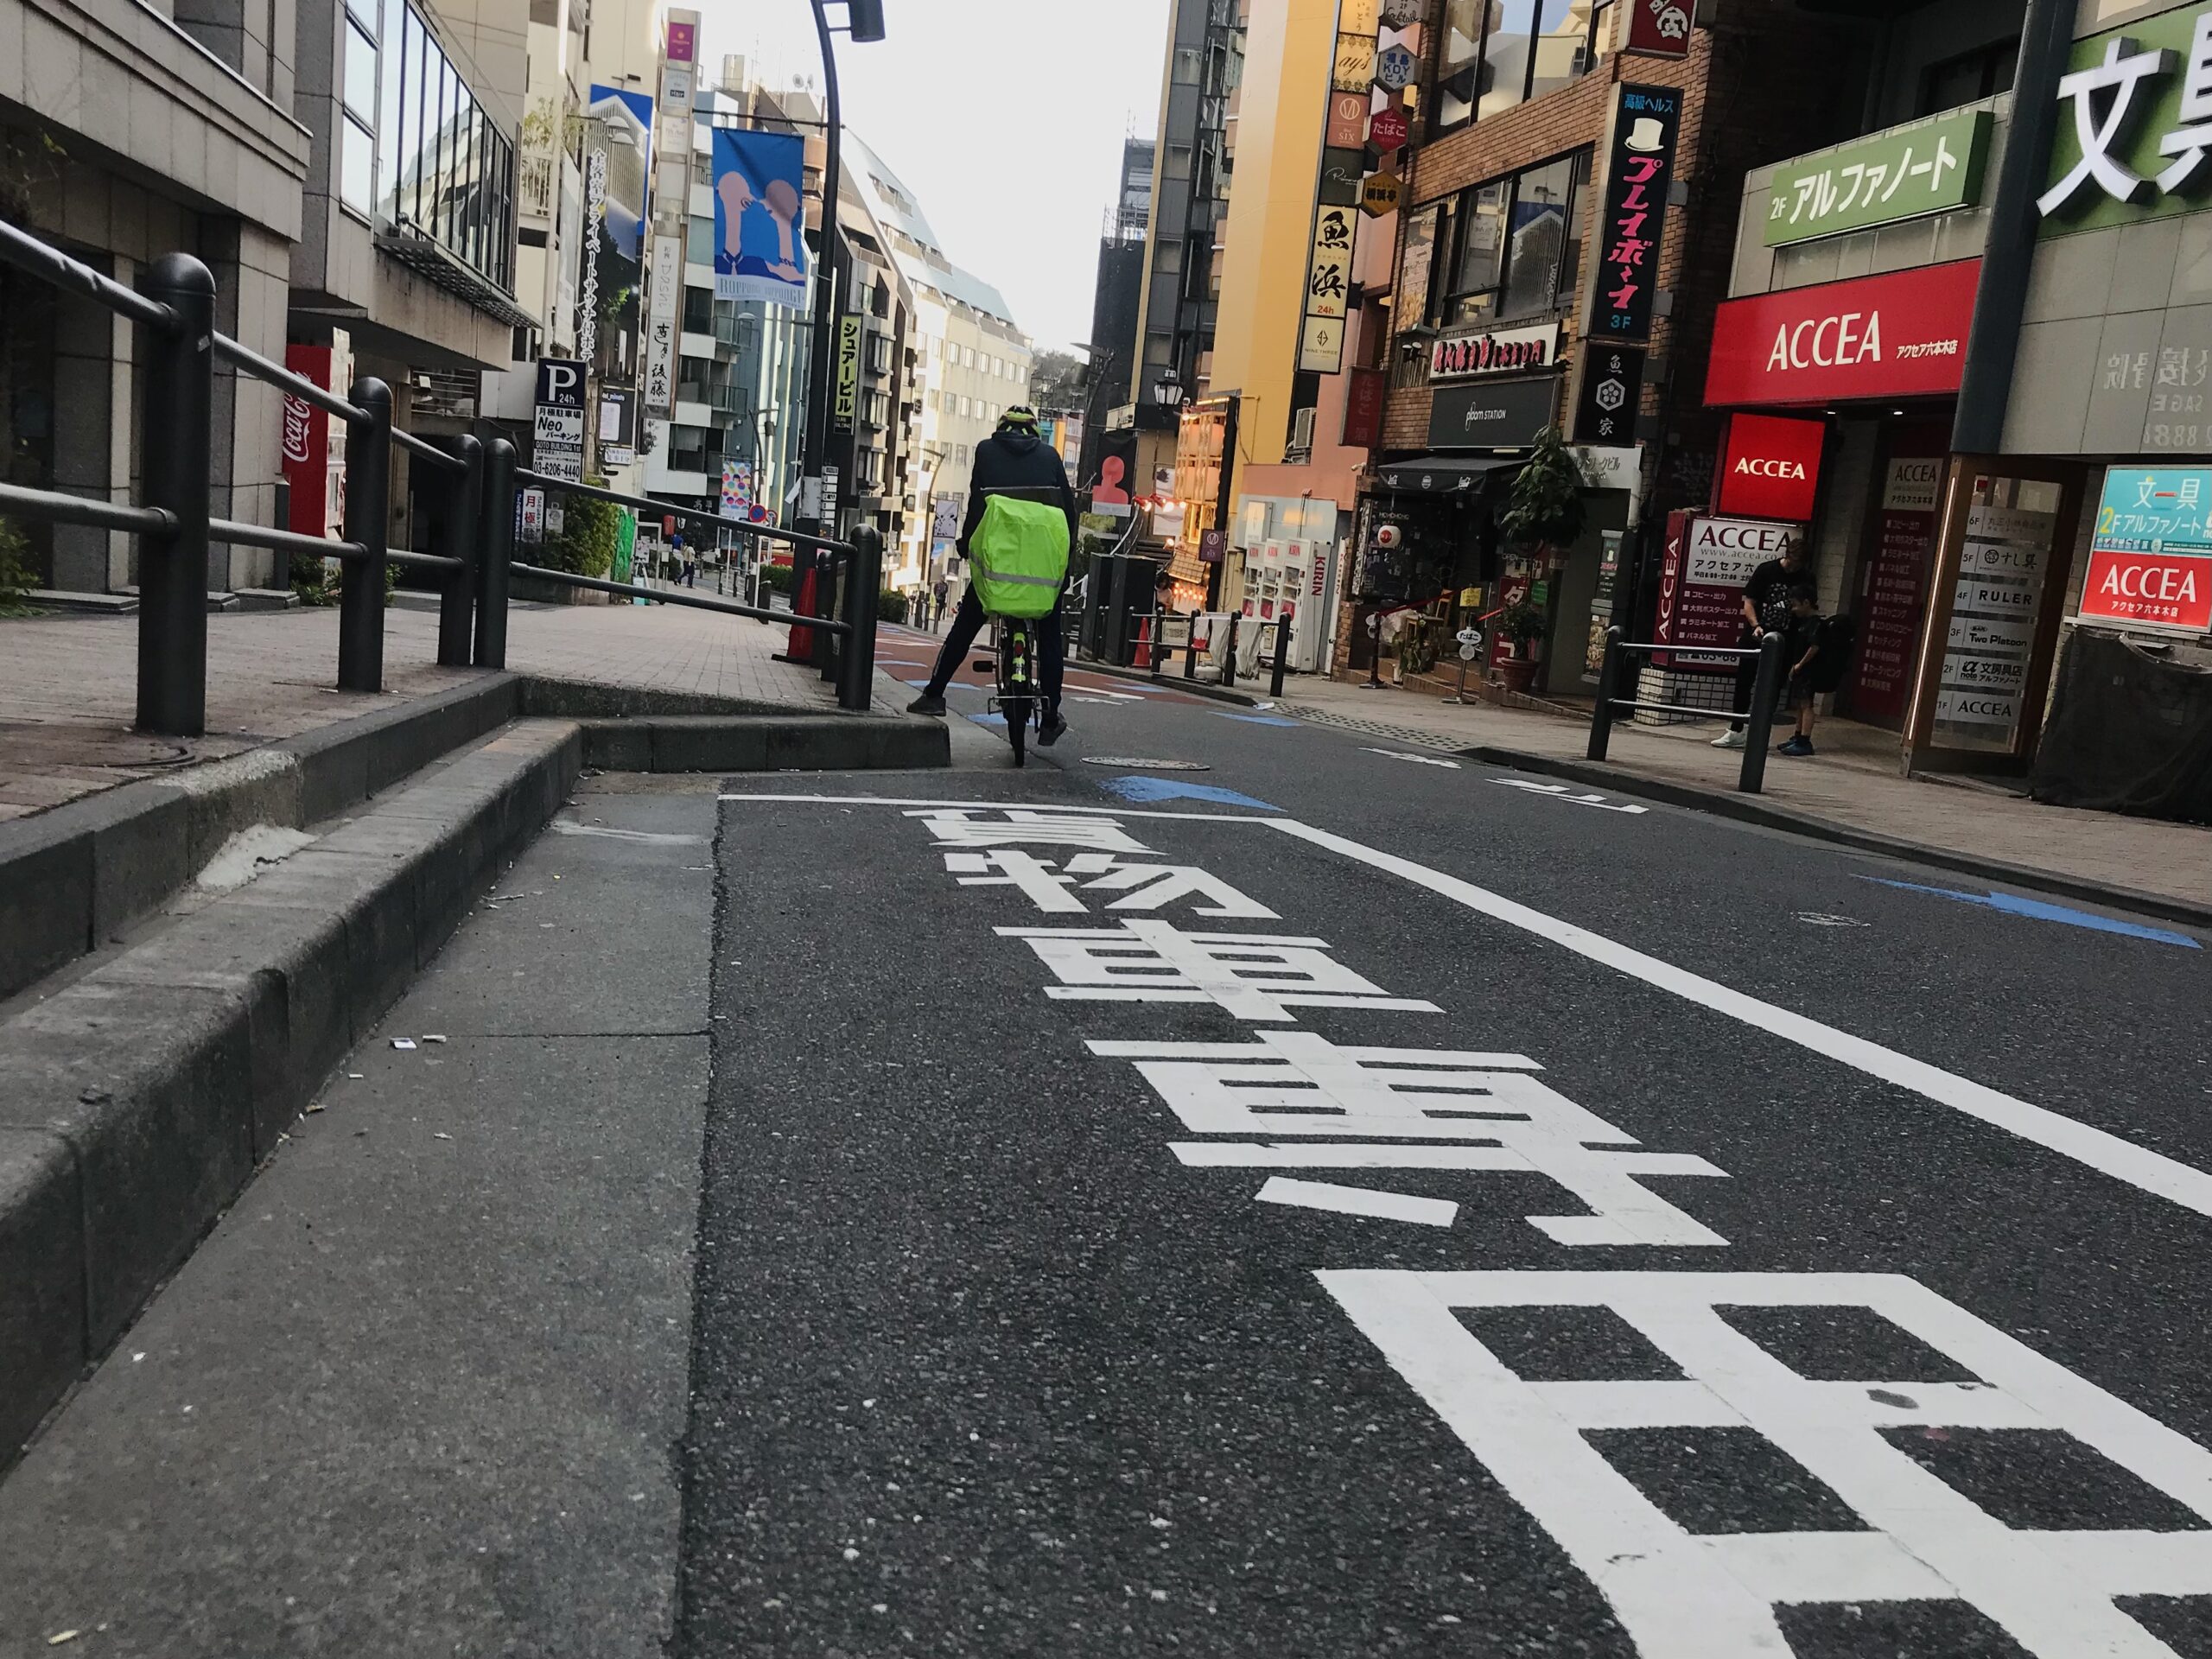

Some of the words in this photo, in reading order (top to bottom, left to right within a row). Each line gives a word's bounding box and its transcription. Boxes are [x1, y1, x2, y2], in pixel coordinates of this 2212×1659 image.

[1383, 63, 1410, 75] KDY
[1624, 93, 1674, 113] 高級ヘルス
[1373, 122, 1406, 137] たばこ
[1789, 136, 1957, 225] アルファノート
[1770, 197, 1787, 220] 2F
[1608, 156, 1663, 309] プレイボーイ
[1317, 305, 1334, 315] 24h
[1611, 315, 1631, 329] 3F
[1766, 310, 1881, 372] ACCEA
[1896, 340, 1959, 359] アクセア六本木店
[837, 322, 858, 413] シュアービル
[545, 365, 577, 402] P
[559, 394, 575, 404] 24h
[539, 408, 582, 419] 月極駐車場
[1465, 402, 1484, 431] ploom
[1484, 409, 1506, 421] STATION
[537, 416, 563, 432] Neo
[546, 432, 581, 442] パーキング
[534, 461, 581, 478] 03-6206-4440
[1734, 457, 1806, 480] ACCEA
[1895, 465, 1936, 482] ACCEA
[2099, 506, 2123, 535] 2F
[2122, 513, 2202, 537] アルファノート
[1698, 525, 1791, 552] ACCEA
[1963, 554, 1974, 563] 5F
[1311, 556, 1325, 596] KIRIN
[2101, 564, 2196, 602] ACCEA
[1659, 537, 1679, 639] ACCEA
[1979, 590, 2032, 605] RULER
[2111, 601, 2179, 617] アクセア六本木店
[1688, 618, 1730, 628] ラミネート加工
[1686, 632, 1718, 641] パネル加工
[1950, 628, 1961, 637] 3F
[1969, 632, 1987, 644] Two
[1989, 634, 2027, 647] Platoon
[1943, 664, 1954, 674] 2F
[1980, 662, 2024, 677] 文房具店
[1978, 675, 2021, 684] アルファノート
[1957, 700, 2012, 717] ACCEA
